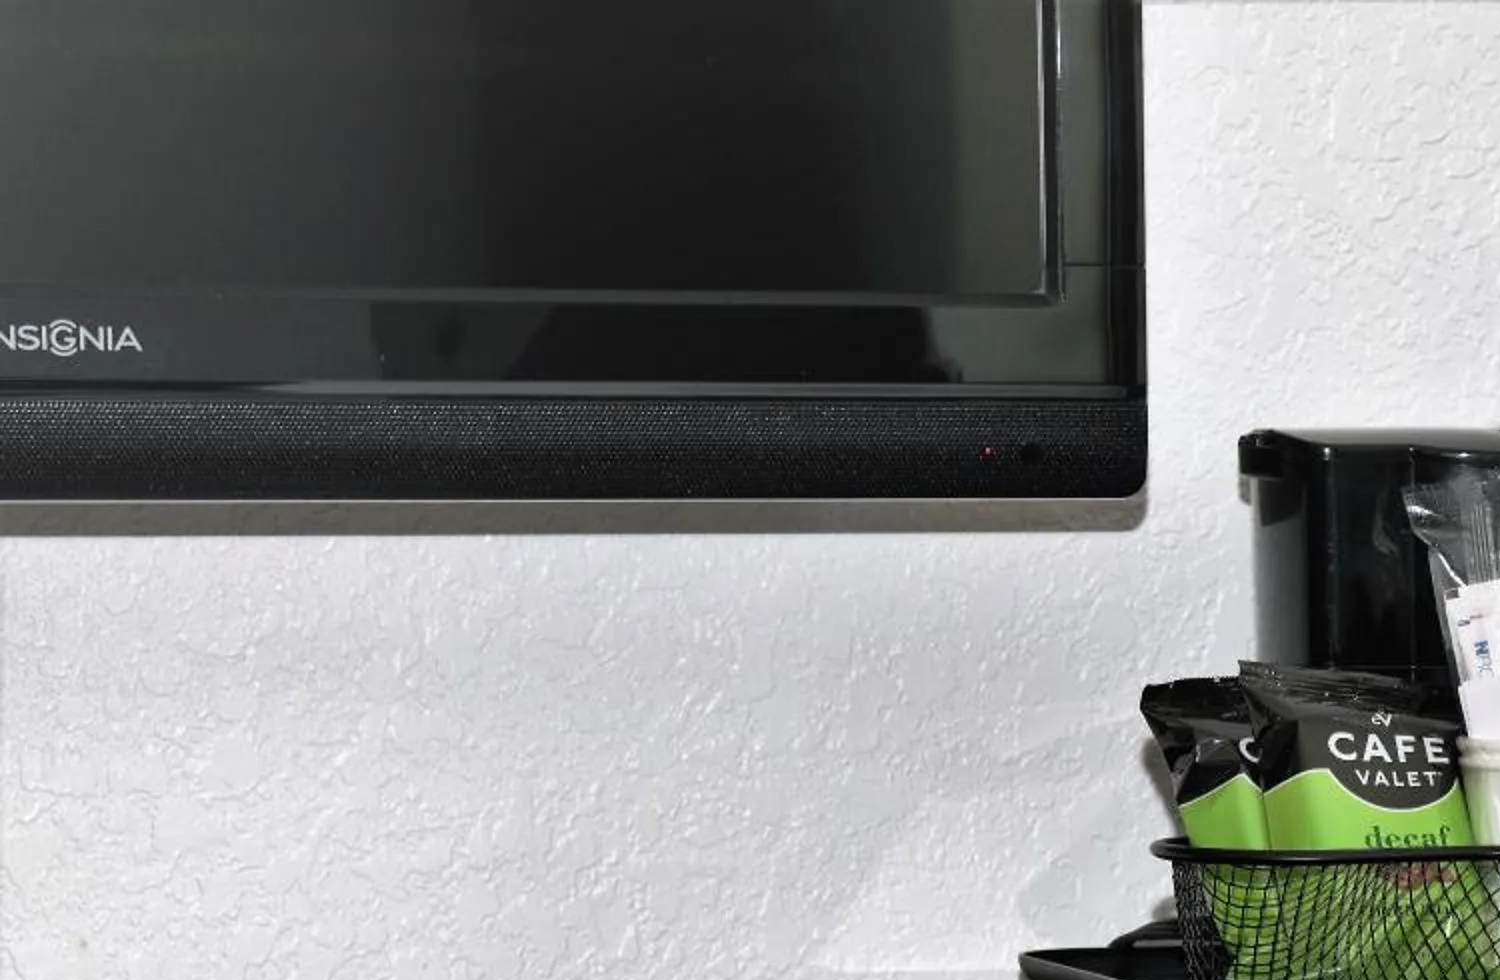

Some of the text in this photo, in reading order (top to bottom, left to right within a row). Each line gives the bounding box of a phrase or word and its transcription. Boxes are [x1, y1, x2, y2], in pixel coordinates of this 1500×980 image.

[1327, 731, 1450, 765] CAFE
[1355, 770, 1440, 788] VALET
[1365, 822, 1452, 849] decaf
